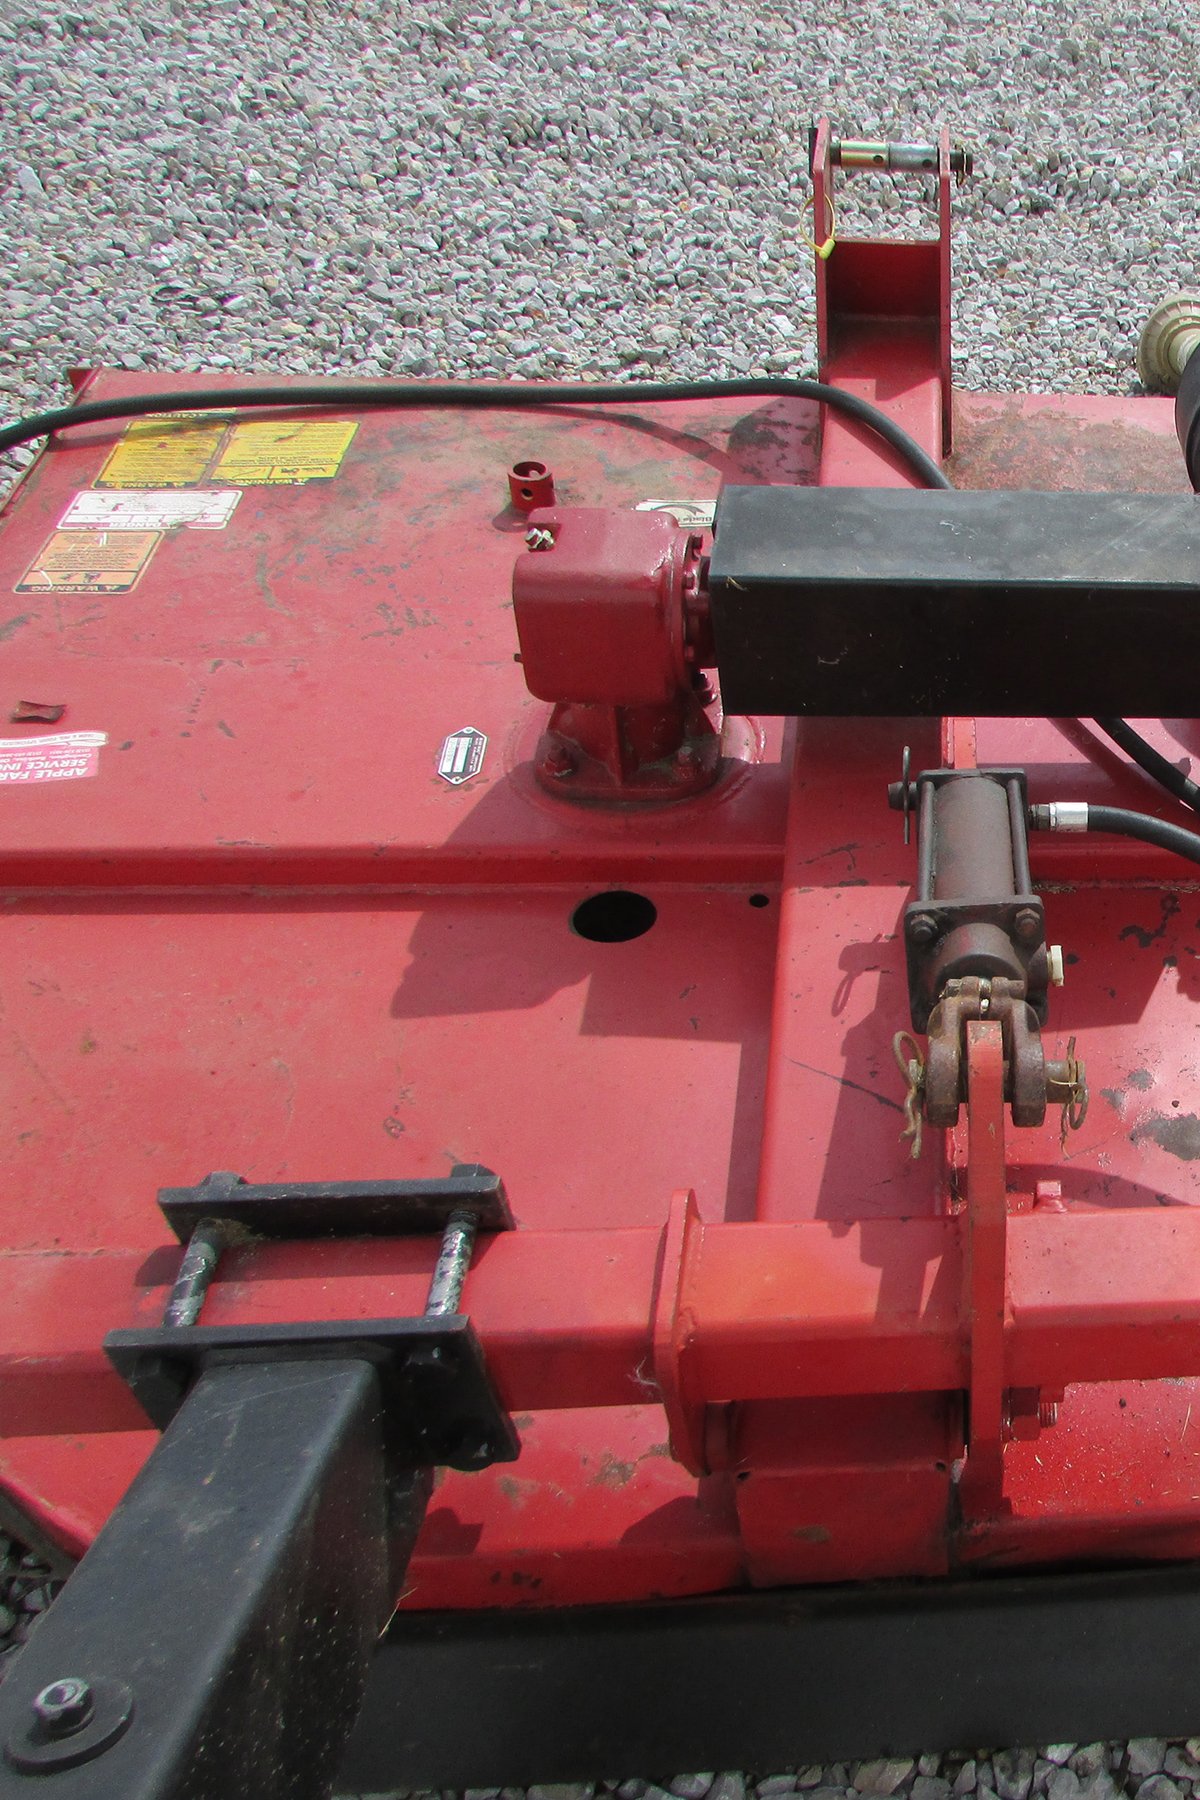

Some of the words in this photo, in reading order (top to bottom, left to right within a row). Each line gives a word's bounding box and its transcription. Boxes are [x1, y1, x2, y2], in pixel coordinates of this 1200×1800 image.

[25, 758, 88, 770] SERVICE
[0, 770, 30, 781] FAR
[34, 767, 89, 779] APPLE
